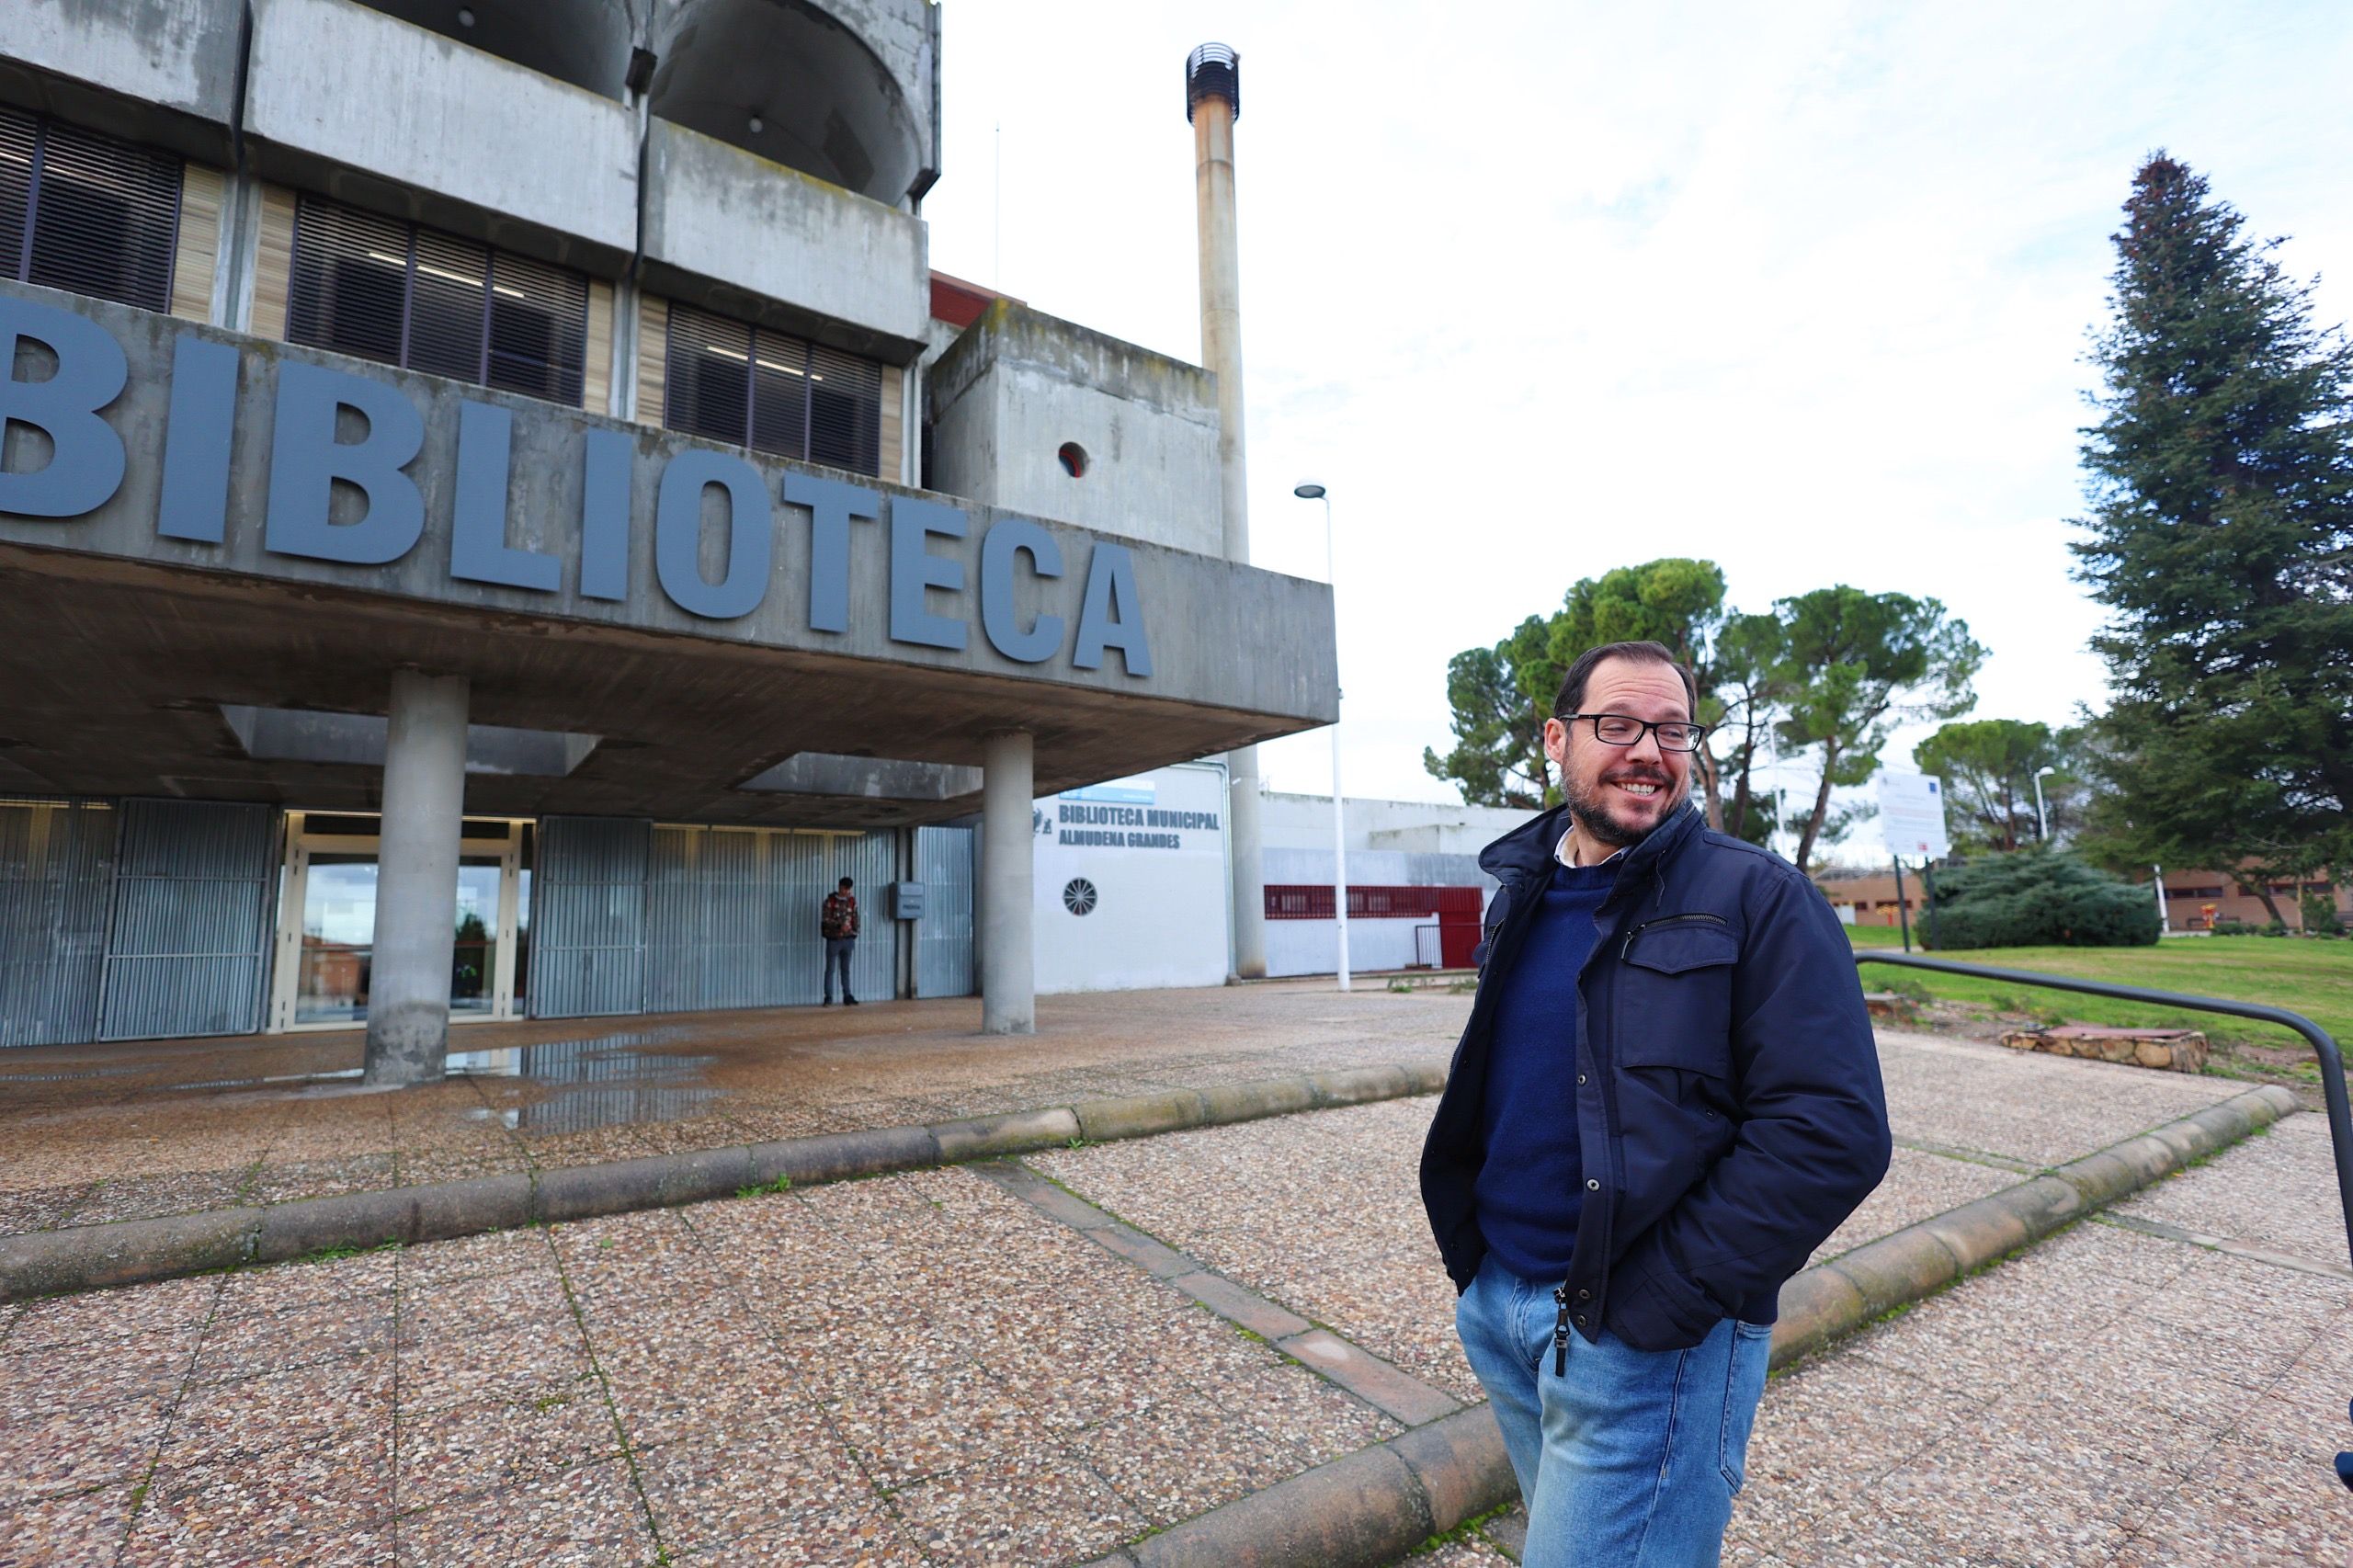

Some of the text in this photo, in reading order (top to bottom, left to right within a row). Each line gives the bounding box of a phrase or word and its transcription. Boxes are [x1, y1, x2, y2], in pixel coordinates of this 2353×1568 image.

[0, 295, 1153, 677] BIBLIOTECA
[1059, 804, 1220, 831] BIBLIOTECA MUNICIPAL
[1059, 829, 1180, 849] ALMUDENA GRANDES
